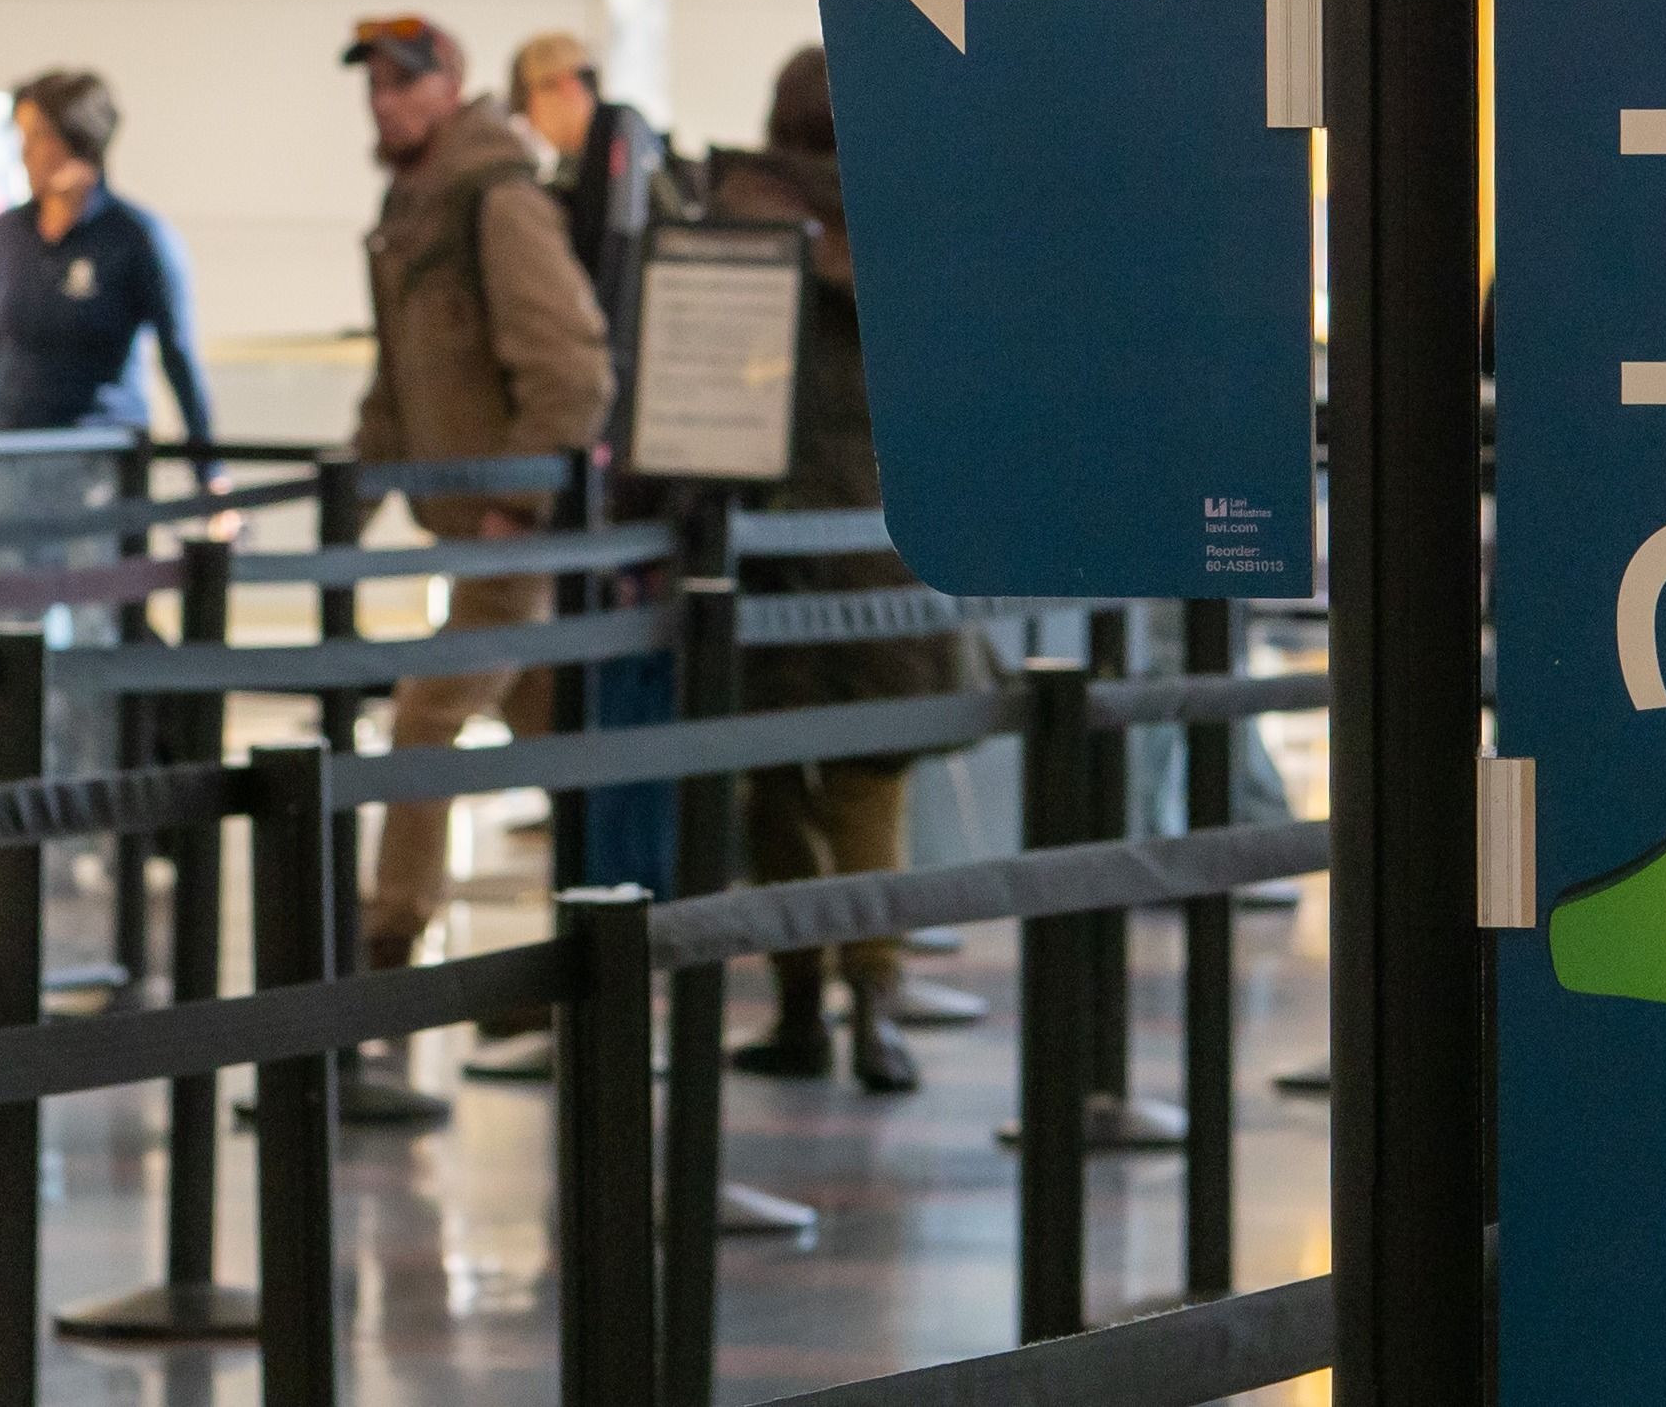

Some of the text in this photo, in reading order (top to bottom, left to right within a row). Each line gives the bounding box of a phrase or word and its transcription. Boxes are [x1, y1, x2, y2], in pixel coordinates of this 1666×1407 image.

[1229, 508, 1272, 517] Industries
[1205, 522, 1258, 533] lavi.com
[1205, 560, 1285, 572] 60-ASB1013
